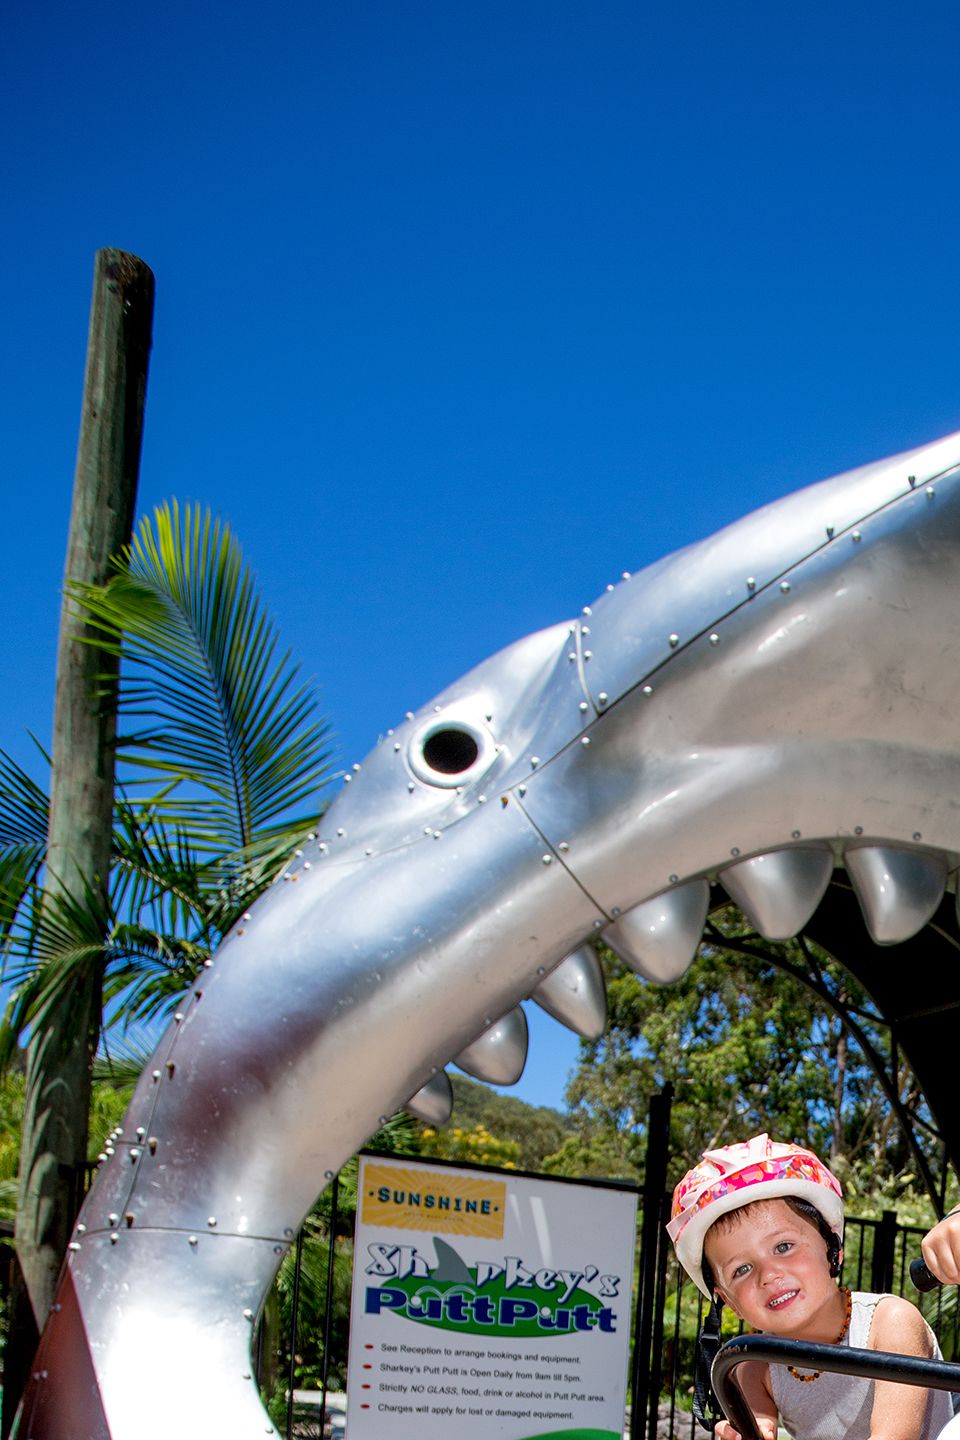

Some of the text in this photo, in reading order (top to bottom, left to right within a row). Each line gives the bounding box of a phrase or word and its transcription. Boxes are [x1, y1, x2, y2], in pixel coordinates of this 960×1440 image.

[377, 1185, 492, 1215] SUNSHINE
[380, 1343, 397, 1353] See
[400, 1344, 441, 1355] Reception
[444, 1347, 452, 1356] to
[454, 1349, 485, 1359] arrange
[487, 1350, 522, 1361] bookings
[524, 1353, 538, 1361] and
[380, 1362, 421, 1374] Sharkey's
[423, 1365, 440, 1375] Putt
[442, 1366, 459, 1376] Putt
[461, 1367, 468, 1376] is
[470, 1368, 491, 1378] Open
[494, 1369, 513, 1379] Daily
[515, 1370, 532, 1379] from
[535, 1372, 551, 1380] 9am
[553, 1373, 562, 1381] till
[379, 1383, 407, 1393] Strictly
[410, 1384, 424, 1393] NO
[461, 1387, 481, 1397] food,
[483, 1388, 502, 1397] drink
[515, 1390, 542, 1399] alcohol
[545, 1391, 551, 1399] in
[553, 1392, 569, 1400] Putt
[571, 1392, 586, 1401] Putt
[378, 1403, 574, 1420] Charges will apply for lost or damaged equipment.
